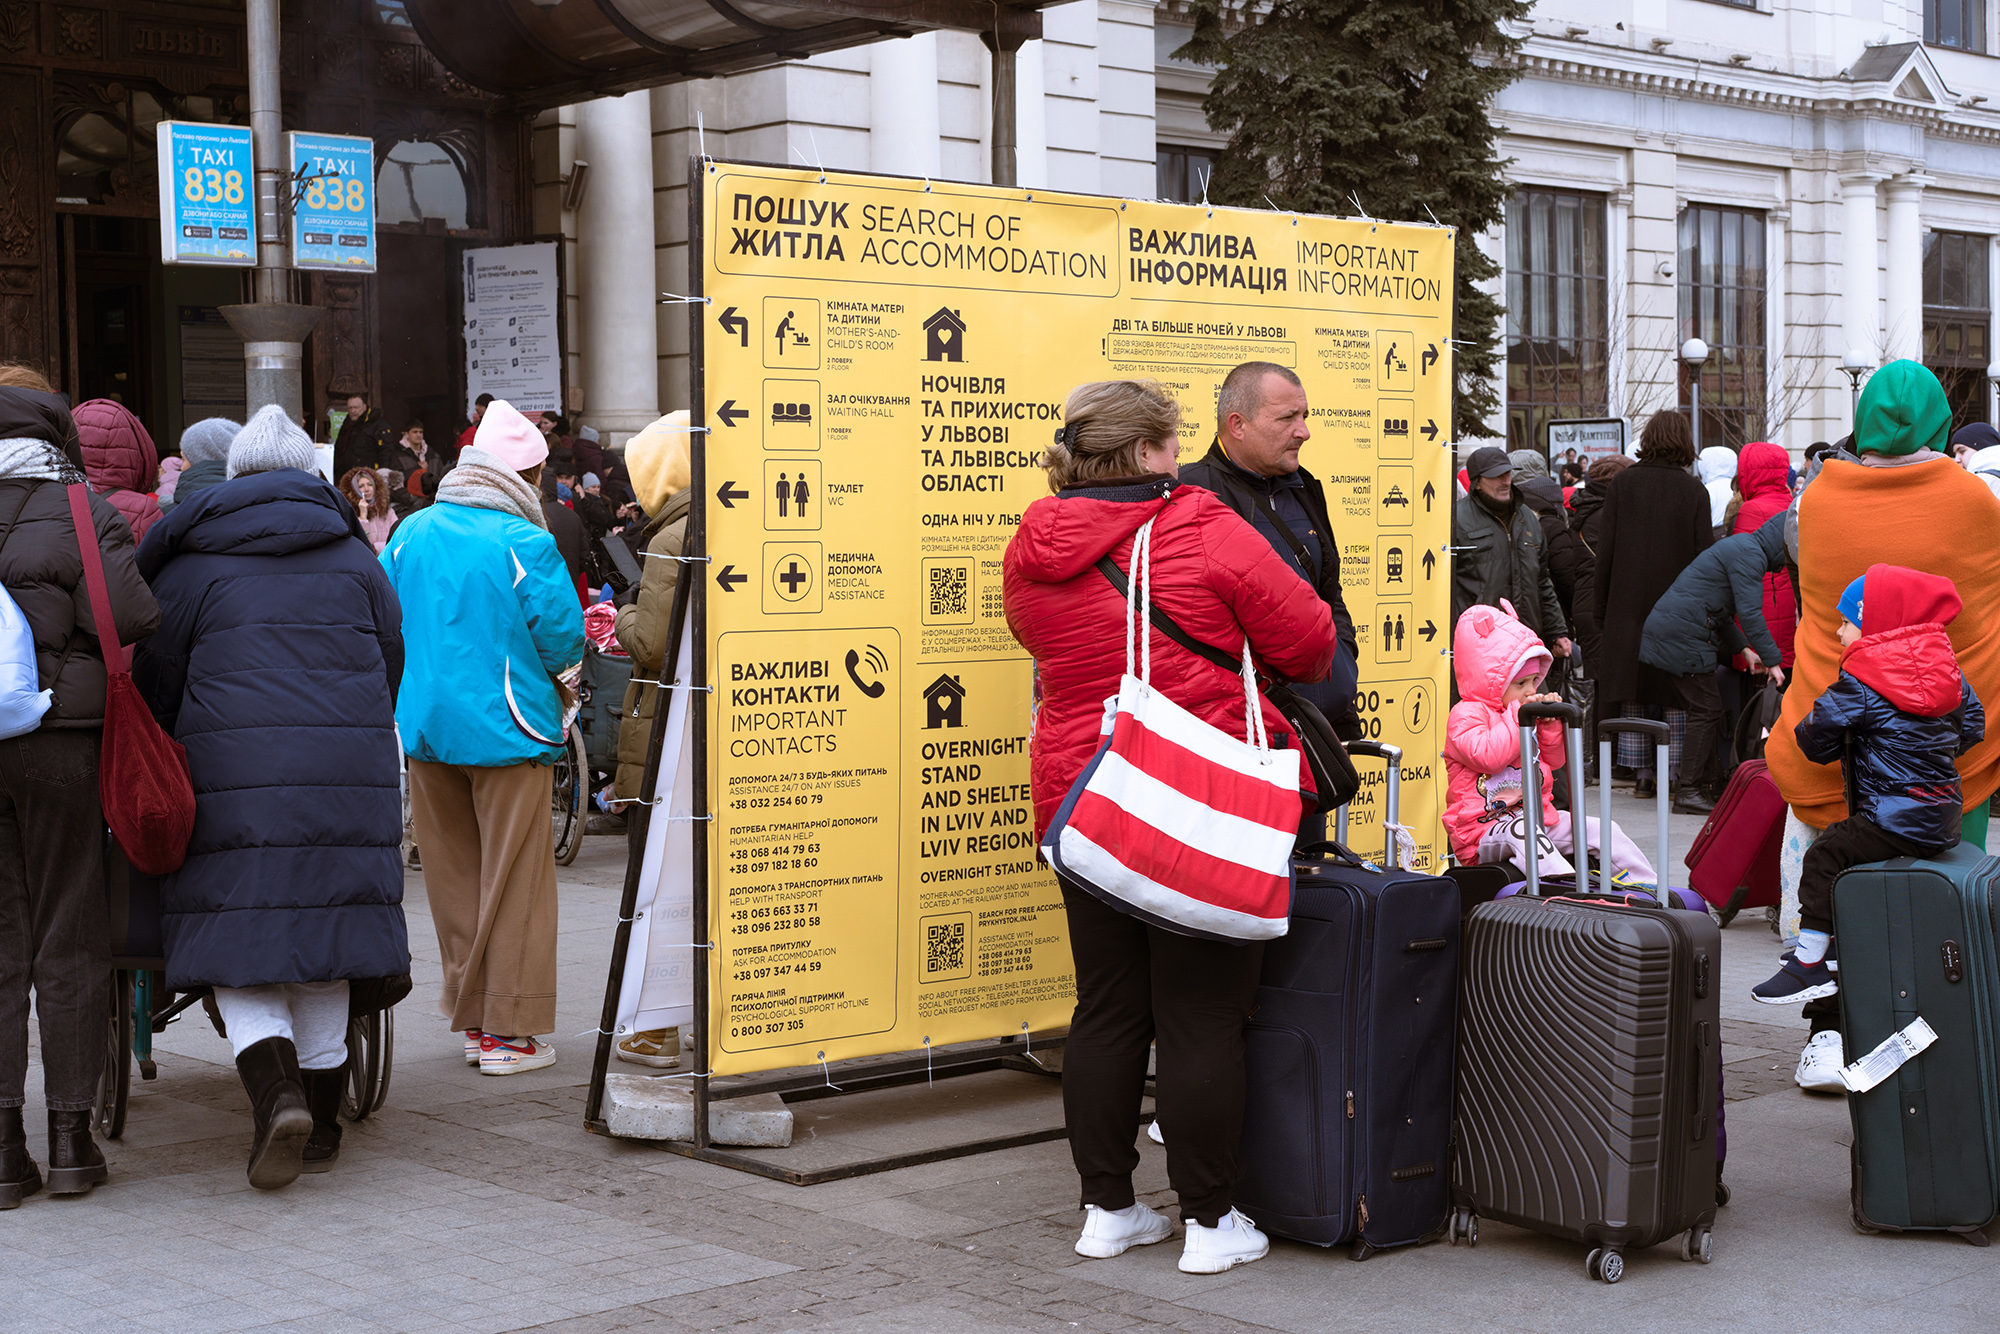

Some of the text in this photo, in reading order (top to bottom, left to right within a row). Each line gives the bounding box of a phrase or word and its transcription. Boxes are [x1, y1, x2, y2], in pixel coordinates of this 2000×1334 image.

[190, 147, 233, 166] TAXI
[313, 157, 355, 175] TAXI
[185, 167, 244, 204] 838
[306, 178, 365, 212] 838
[183, 210, 209, 218] ДЗВОНИ
[224, 211, 247, 220] СКАЧАЙ
[733, 193, 850, 229] ПОШУК
[862, 204, 1021, 242] SEARCH OF
[729, 227, 845, 262] ЖИТЛА
[1129, 227, 1257, 260] ВАЖЛИВА
[860, 237, 1106, 279] ACCOMMODATION
[1297, 240, 1419, 272] IMPORTANT
[1130, 258, 1287, 293] ІНФОРМАЦІЯ
[1298, 269, 1440, 302] INFORMATION
[827, 301, 904, 314] КІМНАТА МАТЕРІ
[827, 313, 880, 325] ТА ДИТИНИ
[1112, 318, 1286, 338] ДВІ ТА БІЛЬШЕ НОЧЕЙ У ЛЬВОВІ
[827, 326, 900, 339] MOTHER'S-AND-
[1315, 327, 1370, 338] КІМНАТА МАТЕРІ
[827, 338, 894, 351] CHILD'S ROOM
[1332, 339, 1370, 349] ТА ДИТИНИ
[922, 375, 1005, 395] НОЧІВЛЯ
[827, 394, 910, 406] ЗАЛ ОЧІКУВАННЯ
[921, 400, 1062, 421] ТА ПРИХИСТОК
[1311, 408, 1371, 418] ЗАЛ ОЧІКУВАННЯ
[1323, 420, 1371, 429] WAITING HALL
[921, 425, 1008, 444] У ЛЬВОВІ
[921, 449, 1041, 468] ТА ЛЬВІВСЬК
[828, 484, 864, 493] ТУАЛЕТ
[921, 474, 1003, 492] ОБЛАСТІ
[1331, 475, 1371, 484] ЗАЛІЗНИЧНІ
[1353, 485, 1371, 494] КОЛІЇ
[828, 496, 844, 506] WC
[1342, 497, 1371, 506] RAILWAY
[1345, 507, 1371, 516] TRACKS
[922, 514, 1021, 528] ОДНА НІЧ У ЛЬВ
[828, 553, 875, 564] МЕДИЧНА
[1345, 545, 1370, 554] 5 ПЕРОН
[1343, 556, 1370, 565] ПОЛЬЩІ
[828, 565, 883, 576] ДОПОМОГА
[1341, 567, 1370, 576] RAILWAY
[828, 578, 870, 588] MEDICAL
[1342, 578, 1370, 587] POLAND
[828, 590, 885, 601] ASSISTANCE
[1358, 635, 1369, 644] WC
[731, 660, 829, 682] ВАЖЛИВІ
[732, 684, 839, 707] КОНТАКТИ
[732, 709, 847, 732] IMPORTANT
[730, 734, 837, 758] CONTACTS
[922, 736, 1026, 760] OVERNIGHT
[729, 768, 888, 786] ДОПОМОГА 24/7 З БУДЬ-ЯКИХ ПИТАНЬ
[921, 764, 981, 785] STAND
[730, 794, 823, 810] +38 032 254 60 79
[921, 784, 1031, 810] AND SHELTE
[730, 816, 878, 835] ПОТРЕБА ГУМАНІТАРНОЇ ДОПОМОГИ
[922, 808, 1028, 834] IN LVIV AND
[1326, 810, 1376, 828] CUFEW
[730, 831, 814, 846] HUMANITARIAN HELP
[921, 831, 1033, 858] LVIV REGION
[730, 843, 820, 860] +38 068 414 79 63
[920, 860, 1049, 884] OVERNIGHT STAND IN
[729, 884, 776, 897] ДОПОМОГА
[784, 877, 850, 890] ТРАНСПОРТНИХ
[852, 874, 883, 884] ПИТАНЬ
[920, 887, 985, 901] MOTHER-AND-CHILD
[986, 885, 1005, 894] ROOM
[1006, 883, 1020, 891] AND
[1020, 880, 1048, 889] WAITING
[978, 910, 1004, 919] SEARCH
[1004, 908, 1018, 916] FOR
[1018, 906, 1035, 914] FREE
[978, 914, 1037, 928] PRYKHYSTOK.IN.UA
[732, 940, 812, 957] ПОТРЕБА ПРИТУЛКУ
[731, 988, 786, 1002] ГАРЯЧА ЛІНІЯ
[731, 991, 845, 1013] ПСИХОЛОГІЧНОЇ ПІДТРИМКИ
[918, 990, 1077, 1018] YOU CAN REQUEST MORE INFO FROM VOLUNTEERS
[1899, 1032, 1917, 1052] POZ
